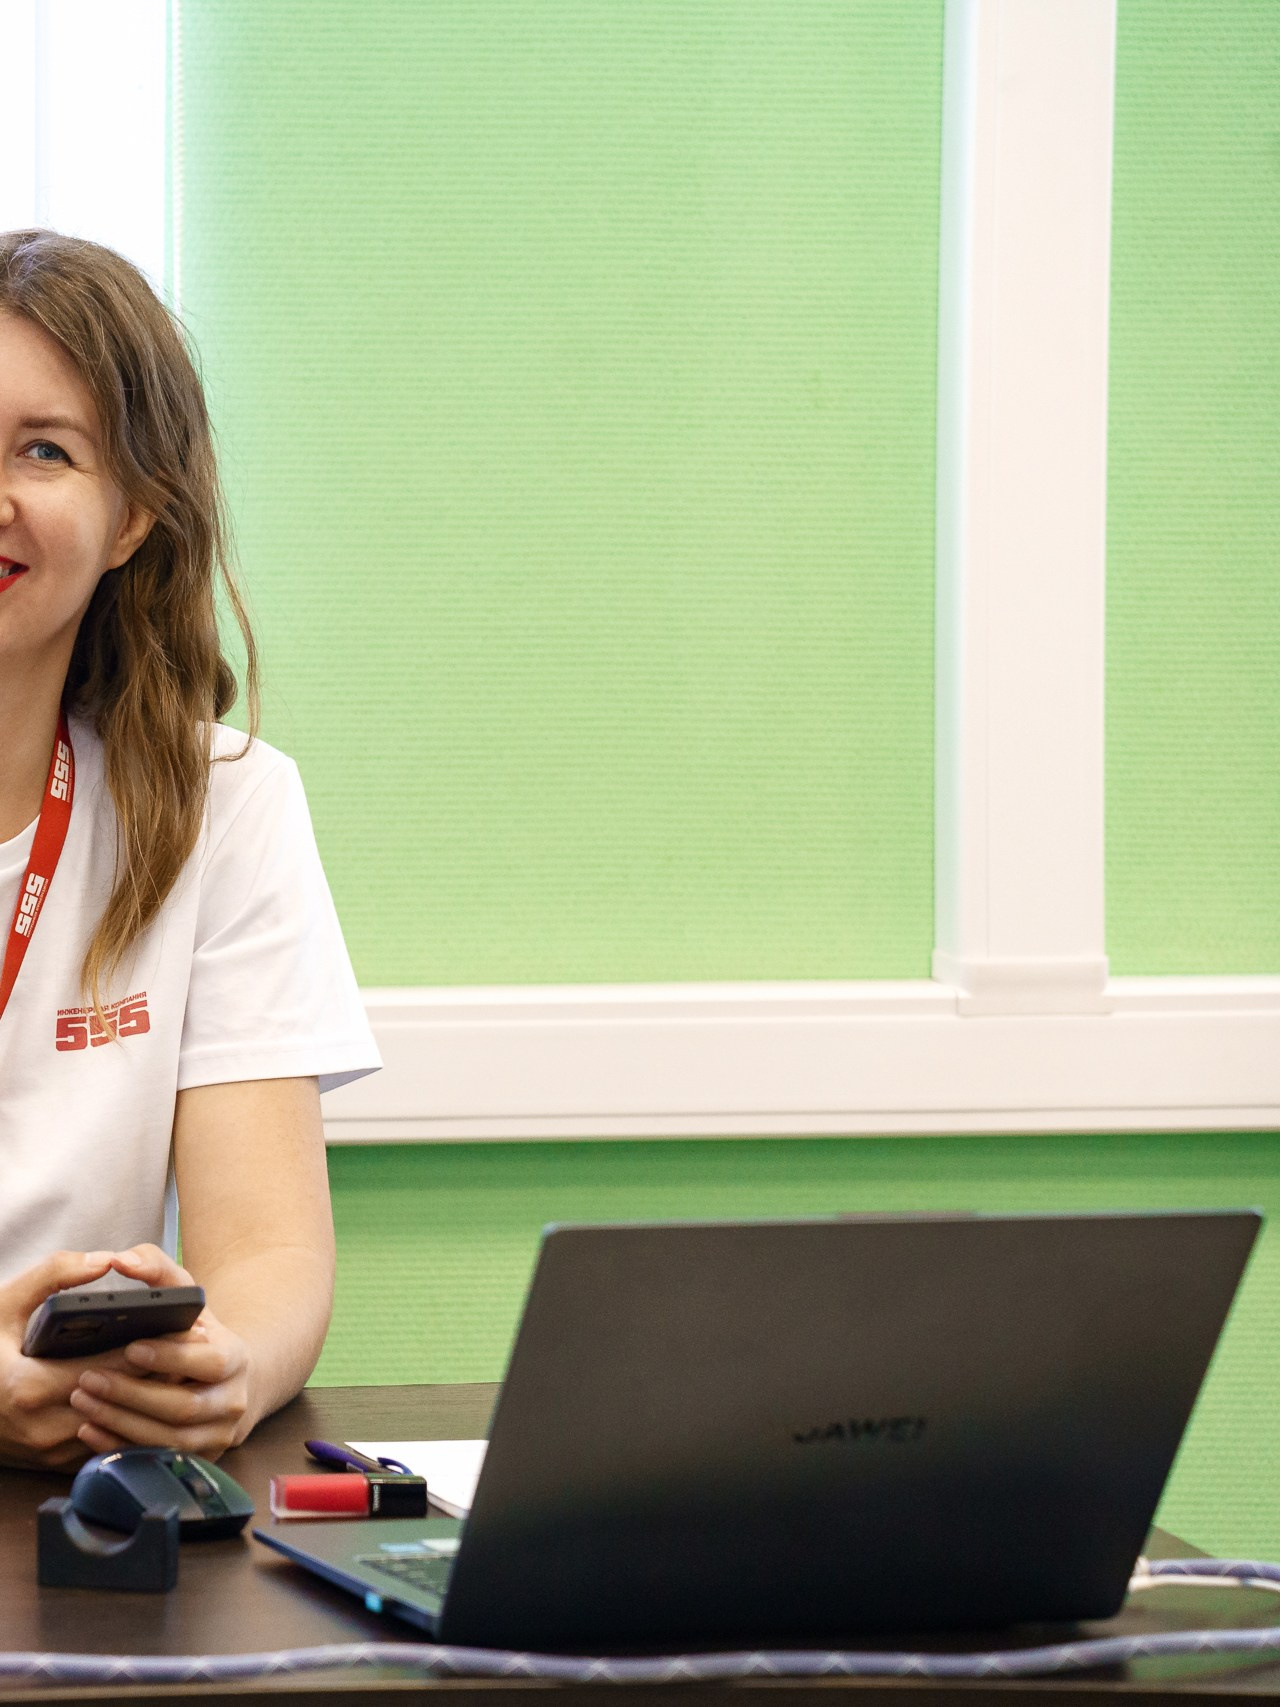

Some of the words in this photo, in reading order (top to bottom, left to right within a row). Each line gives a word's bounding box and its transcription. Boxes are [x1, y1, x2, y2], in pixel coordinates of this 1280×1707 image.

[50, 740, 69, 801] 555
[14, 872, 46, 937] 555
[56, 999, 151, 1051] 555
